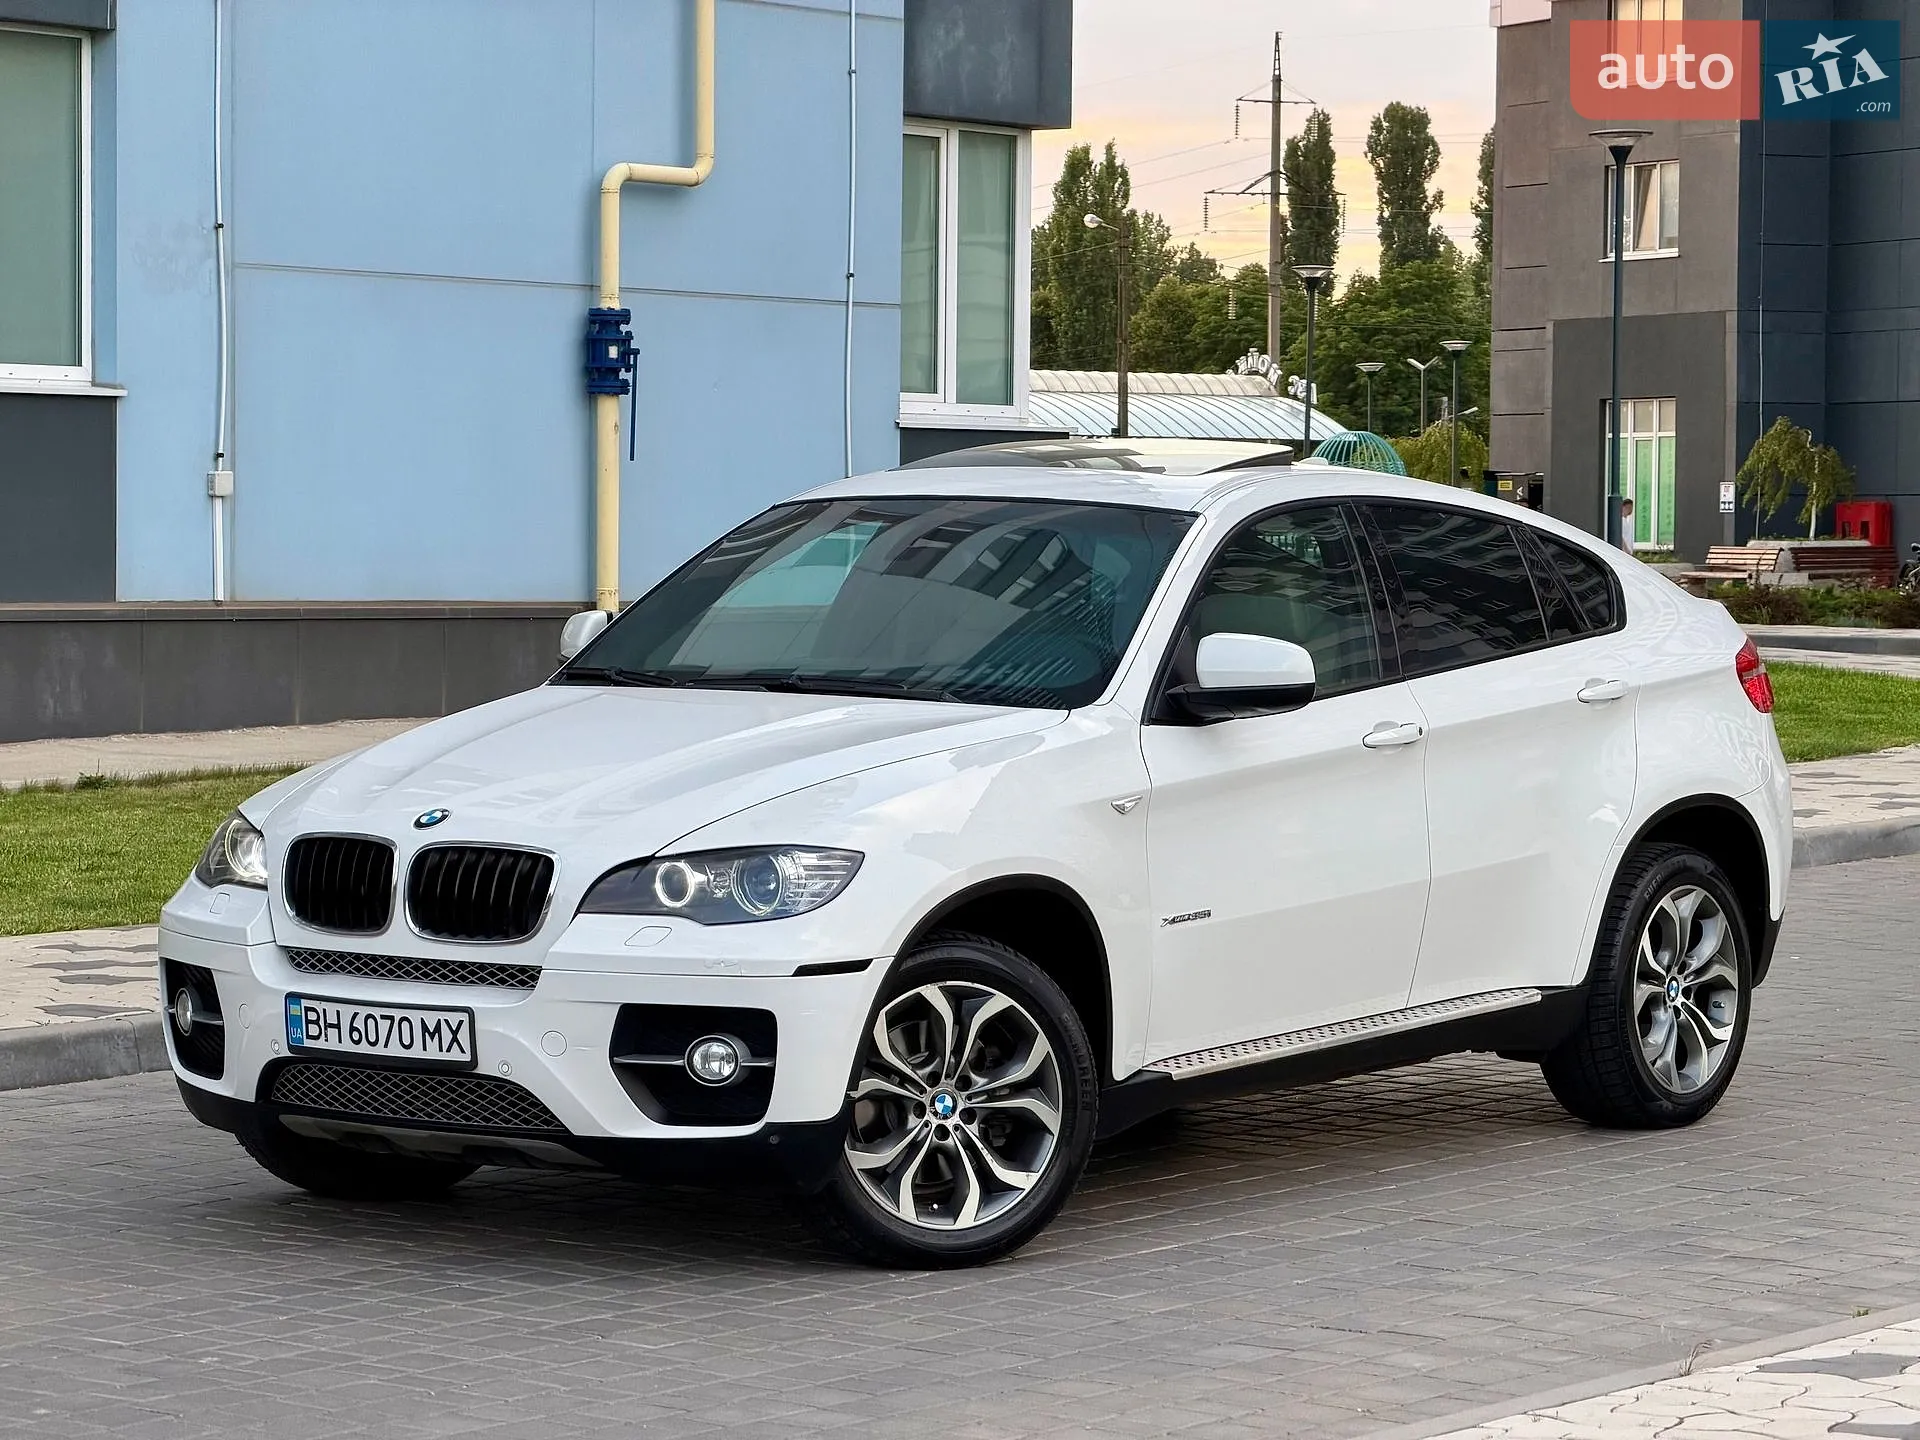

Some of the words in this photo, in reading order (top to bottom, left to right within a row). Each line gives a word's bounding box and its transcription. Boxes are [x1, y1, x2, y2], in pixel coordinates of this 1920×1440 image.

[290, 1028, 303, 1039] UA
[304, 1005, 342, 1044] BH
[349, 1011, 414, 1050] 6070
[420, 1016, 466, 1054] MX
